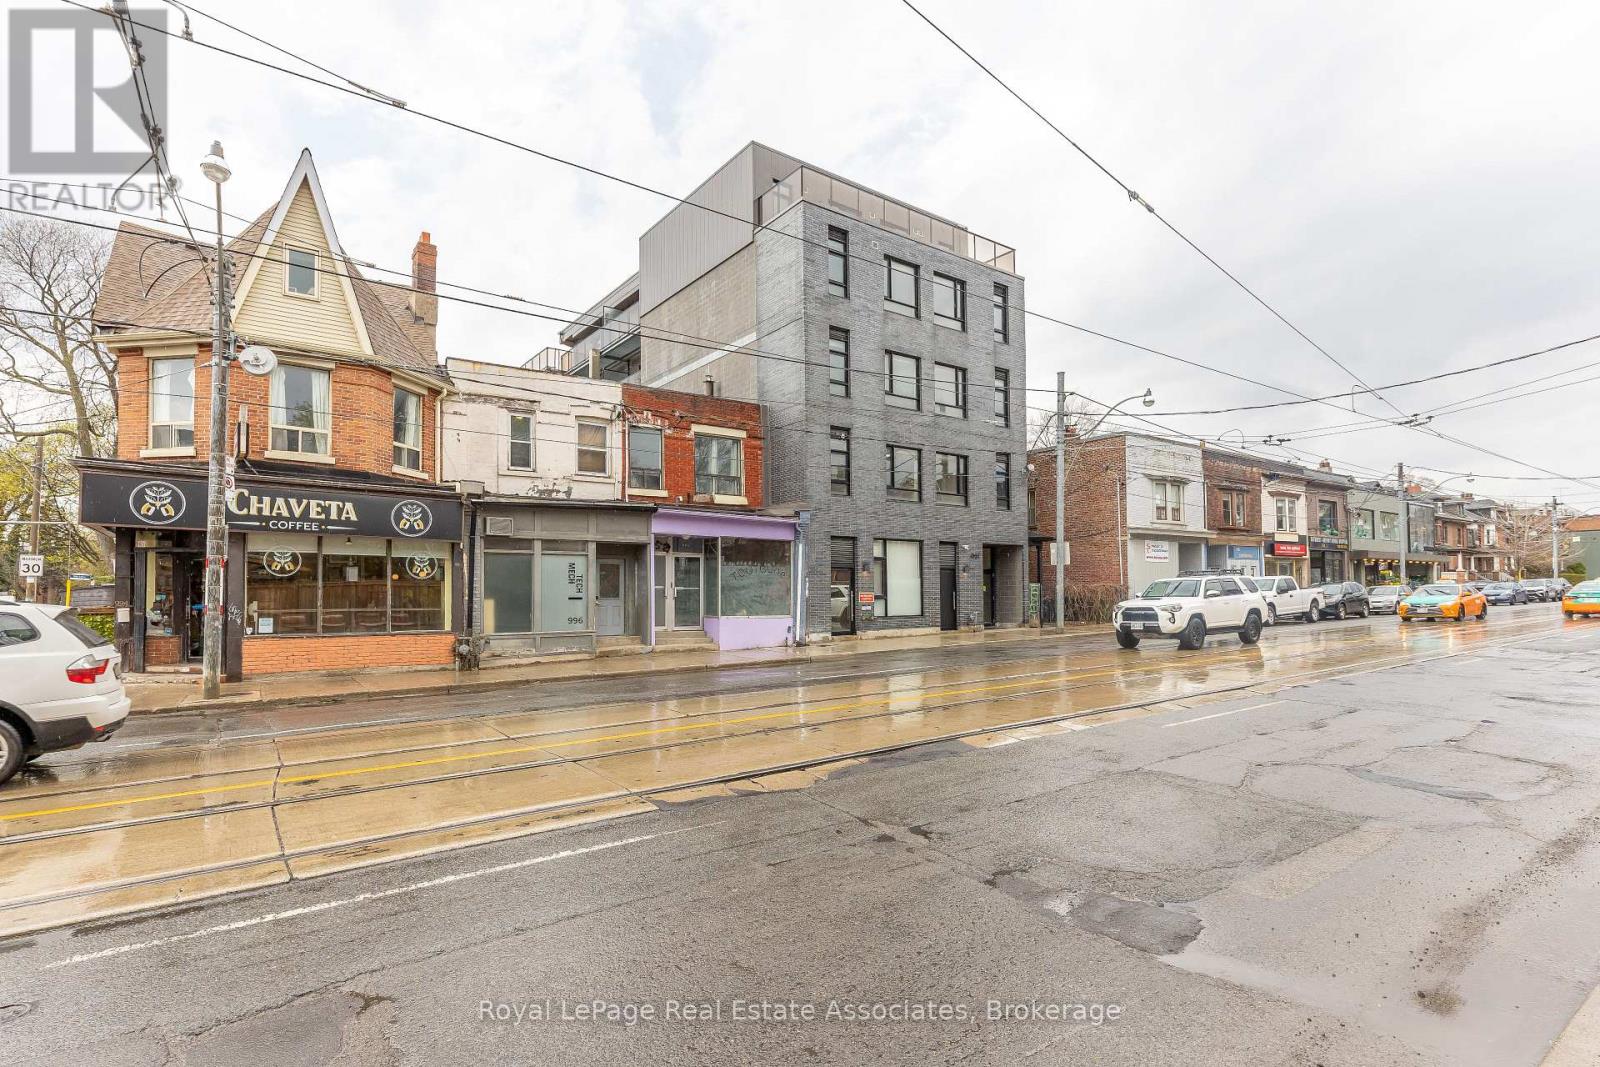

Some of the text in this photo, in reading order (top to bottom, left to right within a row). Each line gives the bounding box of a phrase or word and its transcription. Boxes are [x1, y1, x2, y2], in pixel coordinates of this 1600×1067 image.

[227, 488, 358, 521] CHAVETA
[269, 520, 319, 531] COFFEE
[22, 564, 40, 573] 30
[568, 616, 583, 624] 996
